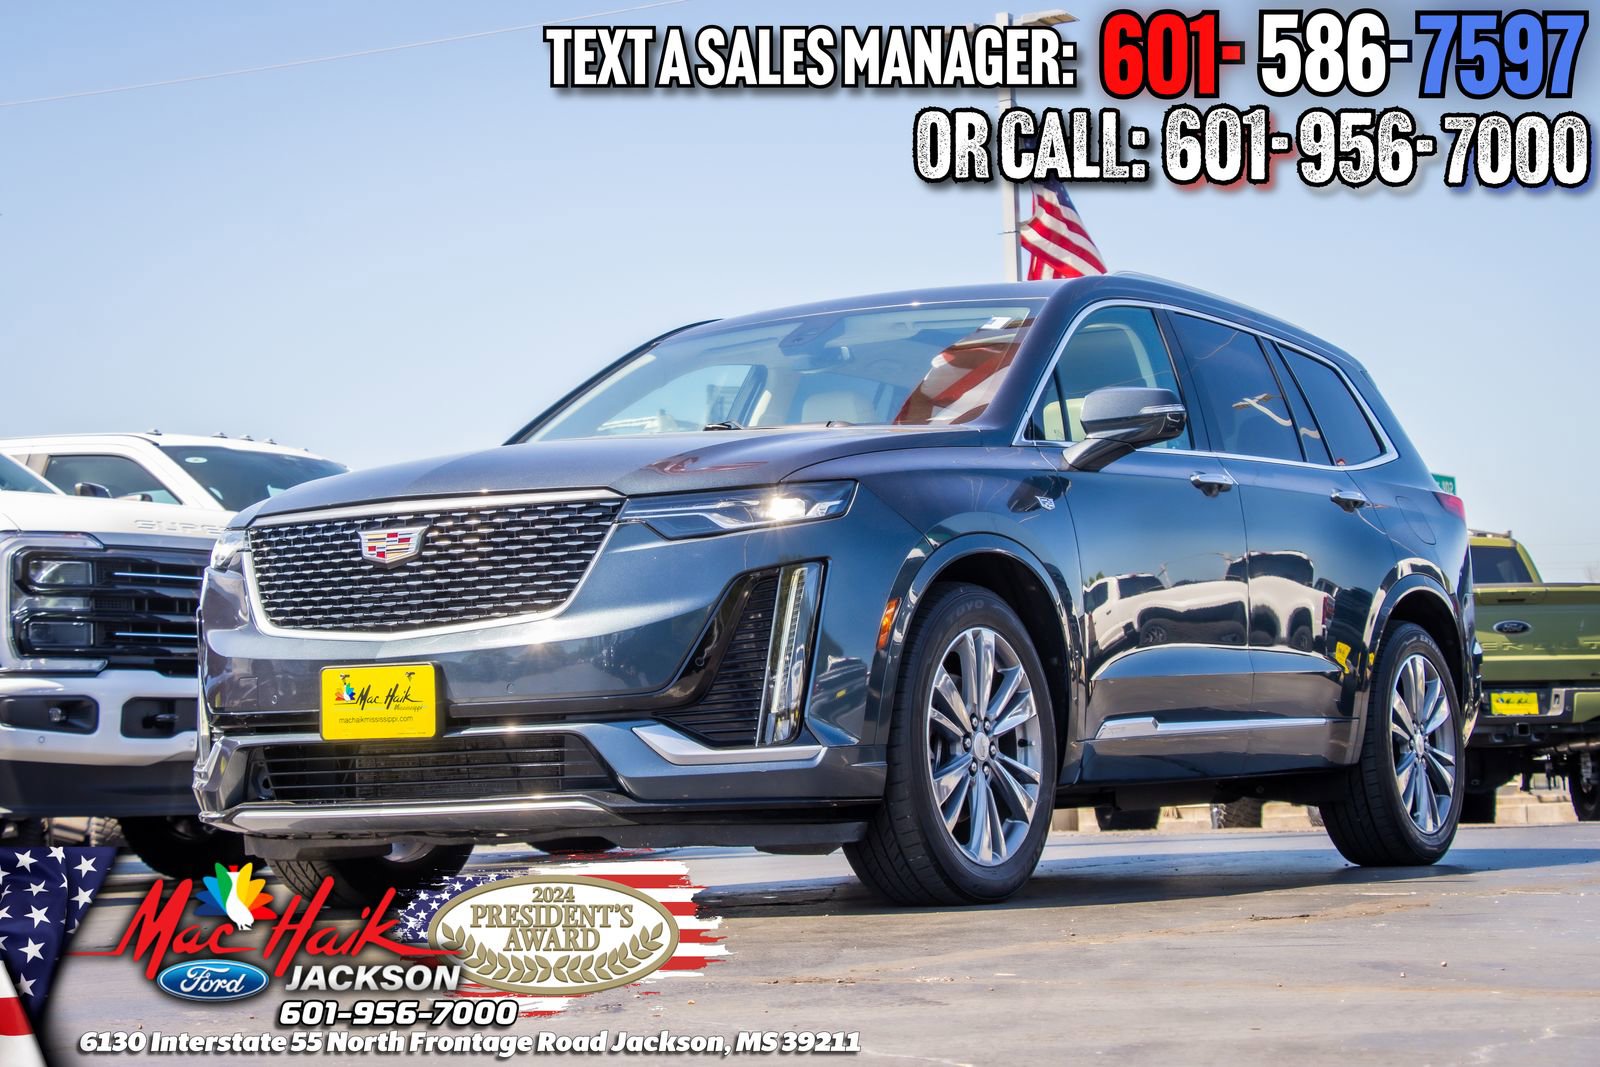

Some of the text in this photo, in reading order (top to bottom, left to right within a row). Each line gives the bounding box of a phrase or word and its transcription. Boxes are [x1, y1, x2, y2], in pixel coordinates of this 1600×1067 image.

[134, 519, 223, 535] SUPE
[349, 683, 424, 710] Mac Haik
